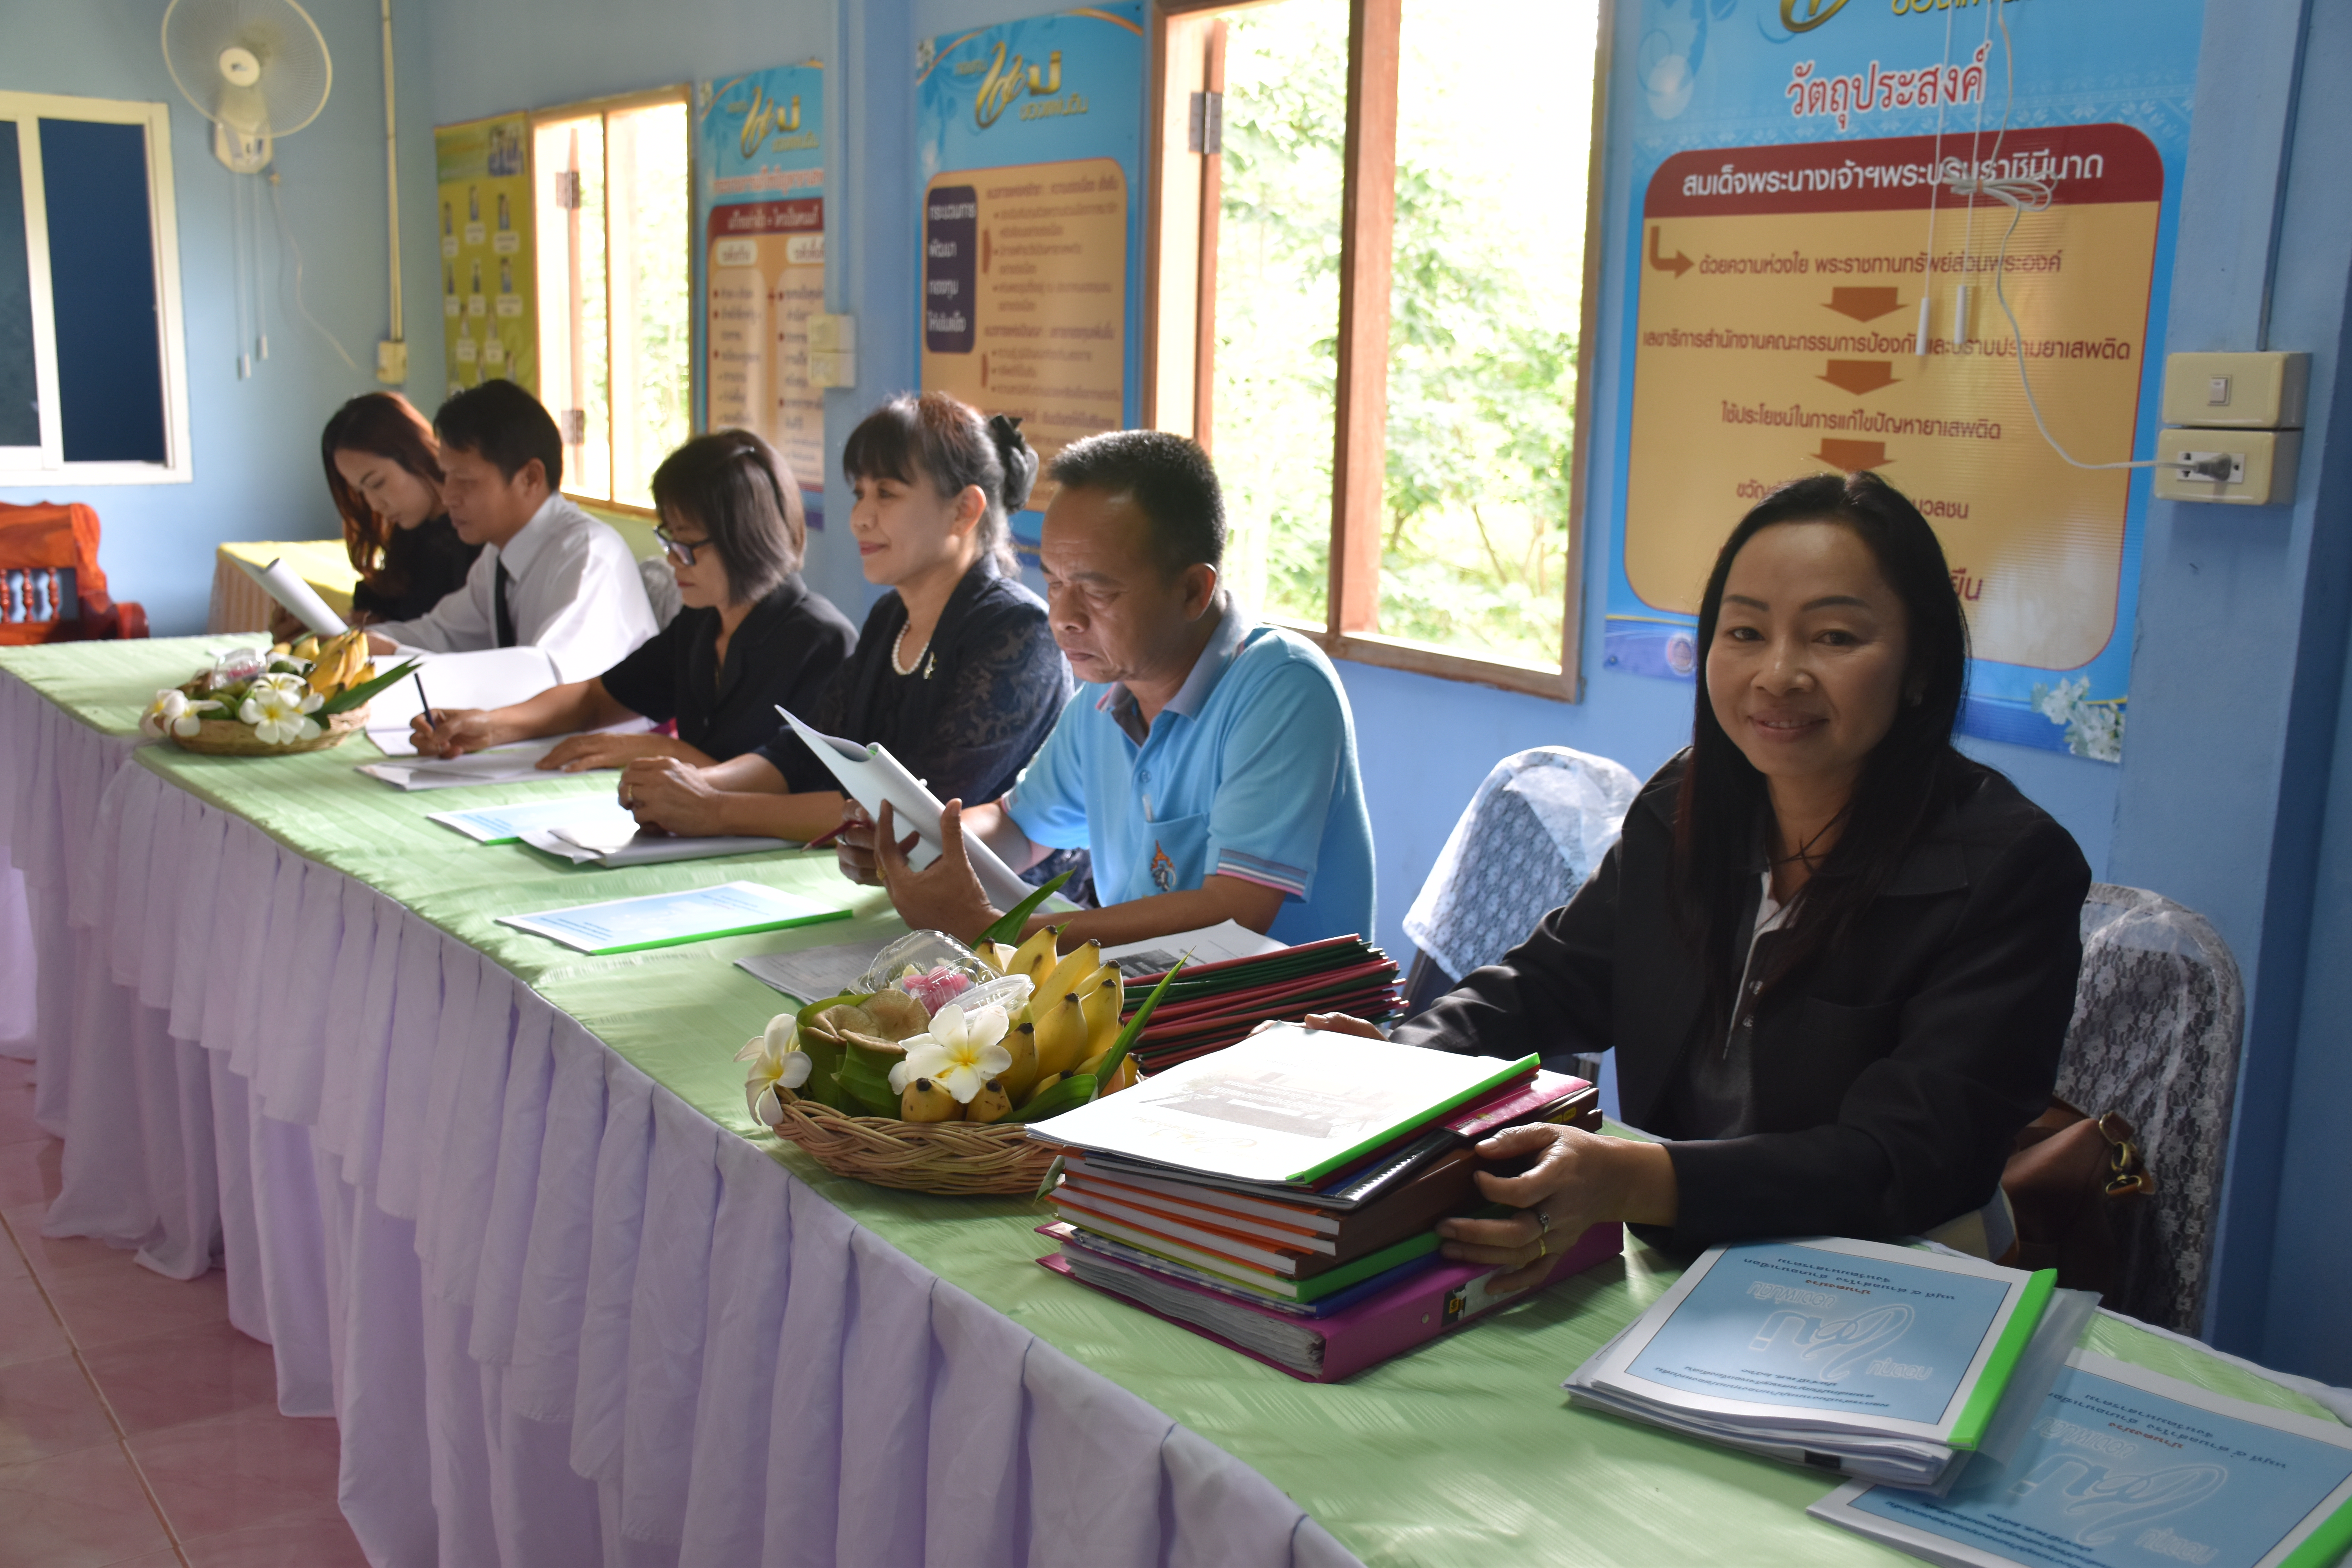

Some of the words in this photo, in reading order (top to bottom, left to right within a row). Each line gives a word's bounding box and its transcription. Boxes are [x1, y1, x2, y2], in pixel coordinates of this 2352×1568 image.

[1786, 40, 1992, 131] วัตถุประสงค์
[1699, 250, 1809, 274] ด้วยความห่วงใย
[1721, 400, 2001, 439] ใช้ประโยชน์ในการแก้ไขปัญหายาเสพติด
[1778, 1258, 1891, 1283] จังหวัดมหาสารคาม
[1747, 1281, 1837, 1308] ของแผ่นดิน
[1866, 1358, 1933, 1381] กองทุน
